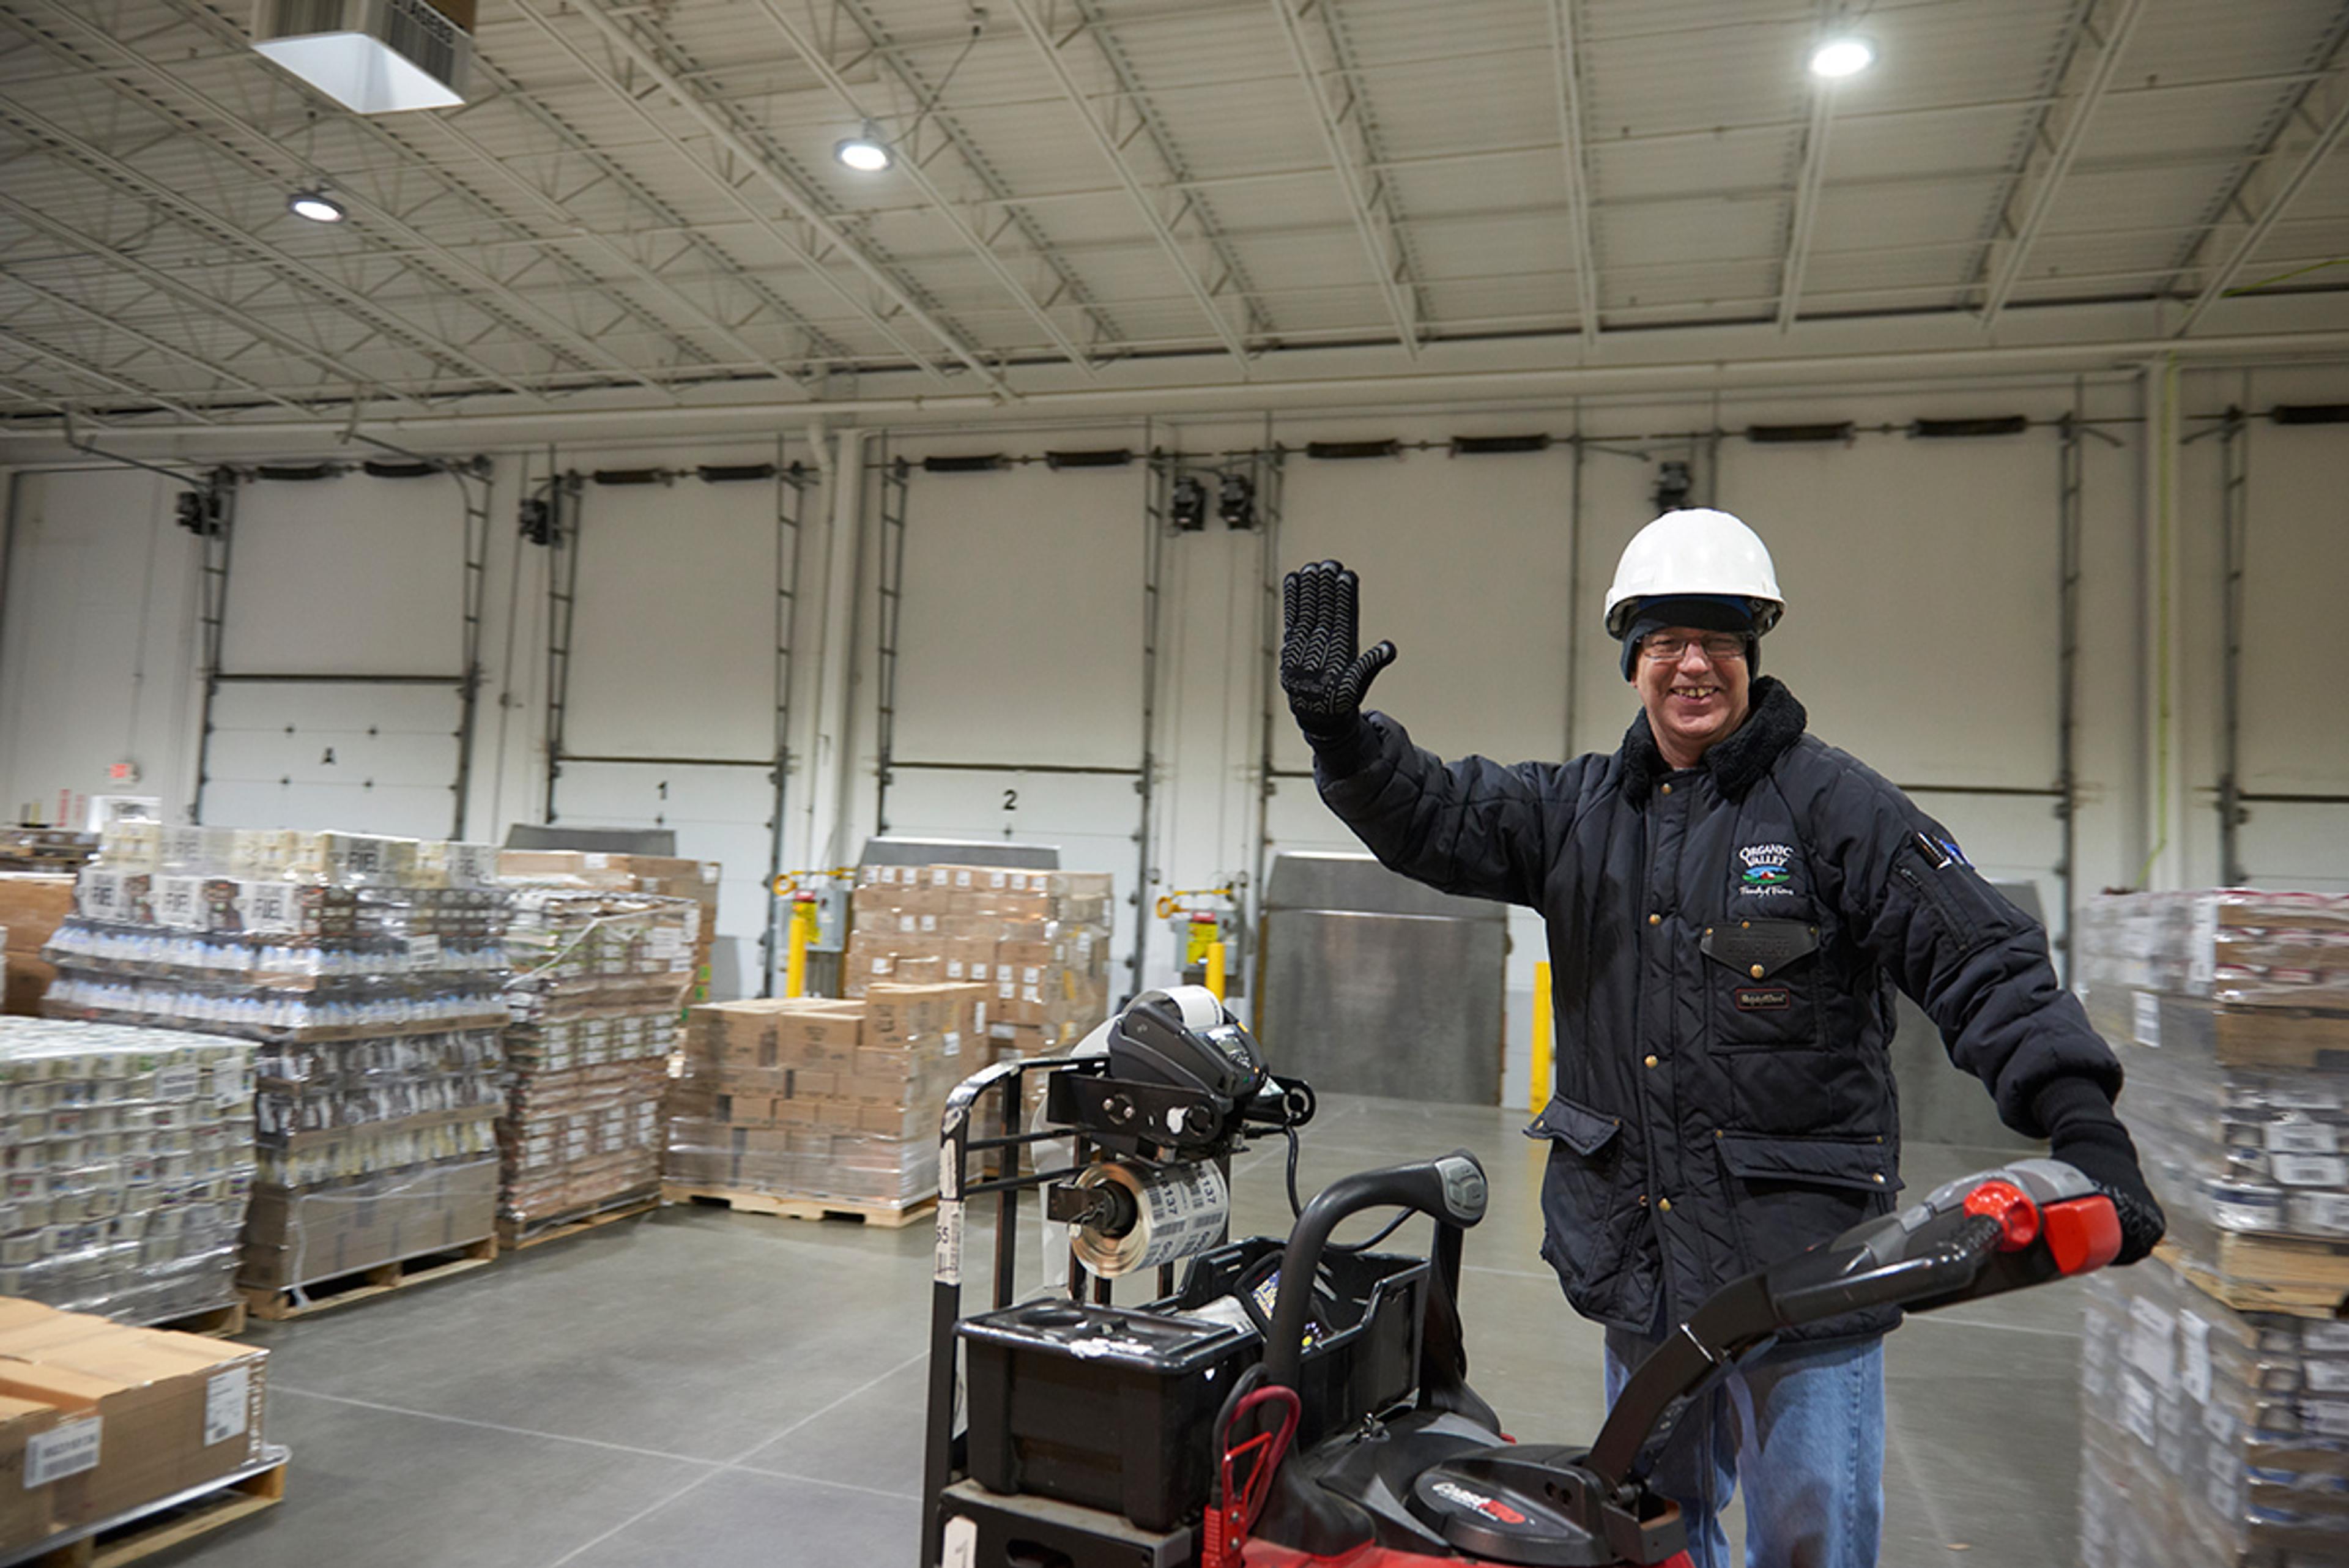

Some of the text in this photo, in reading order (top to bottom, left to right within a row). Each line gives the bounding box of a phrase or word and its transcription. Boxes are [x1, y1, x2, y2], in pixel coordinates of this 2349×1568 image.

[1003, 789, 1017, 811] 2
[1739, 844, 1794, 861] ORGANIC
[1745, 855, 1789, 868] VALLEY
